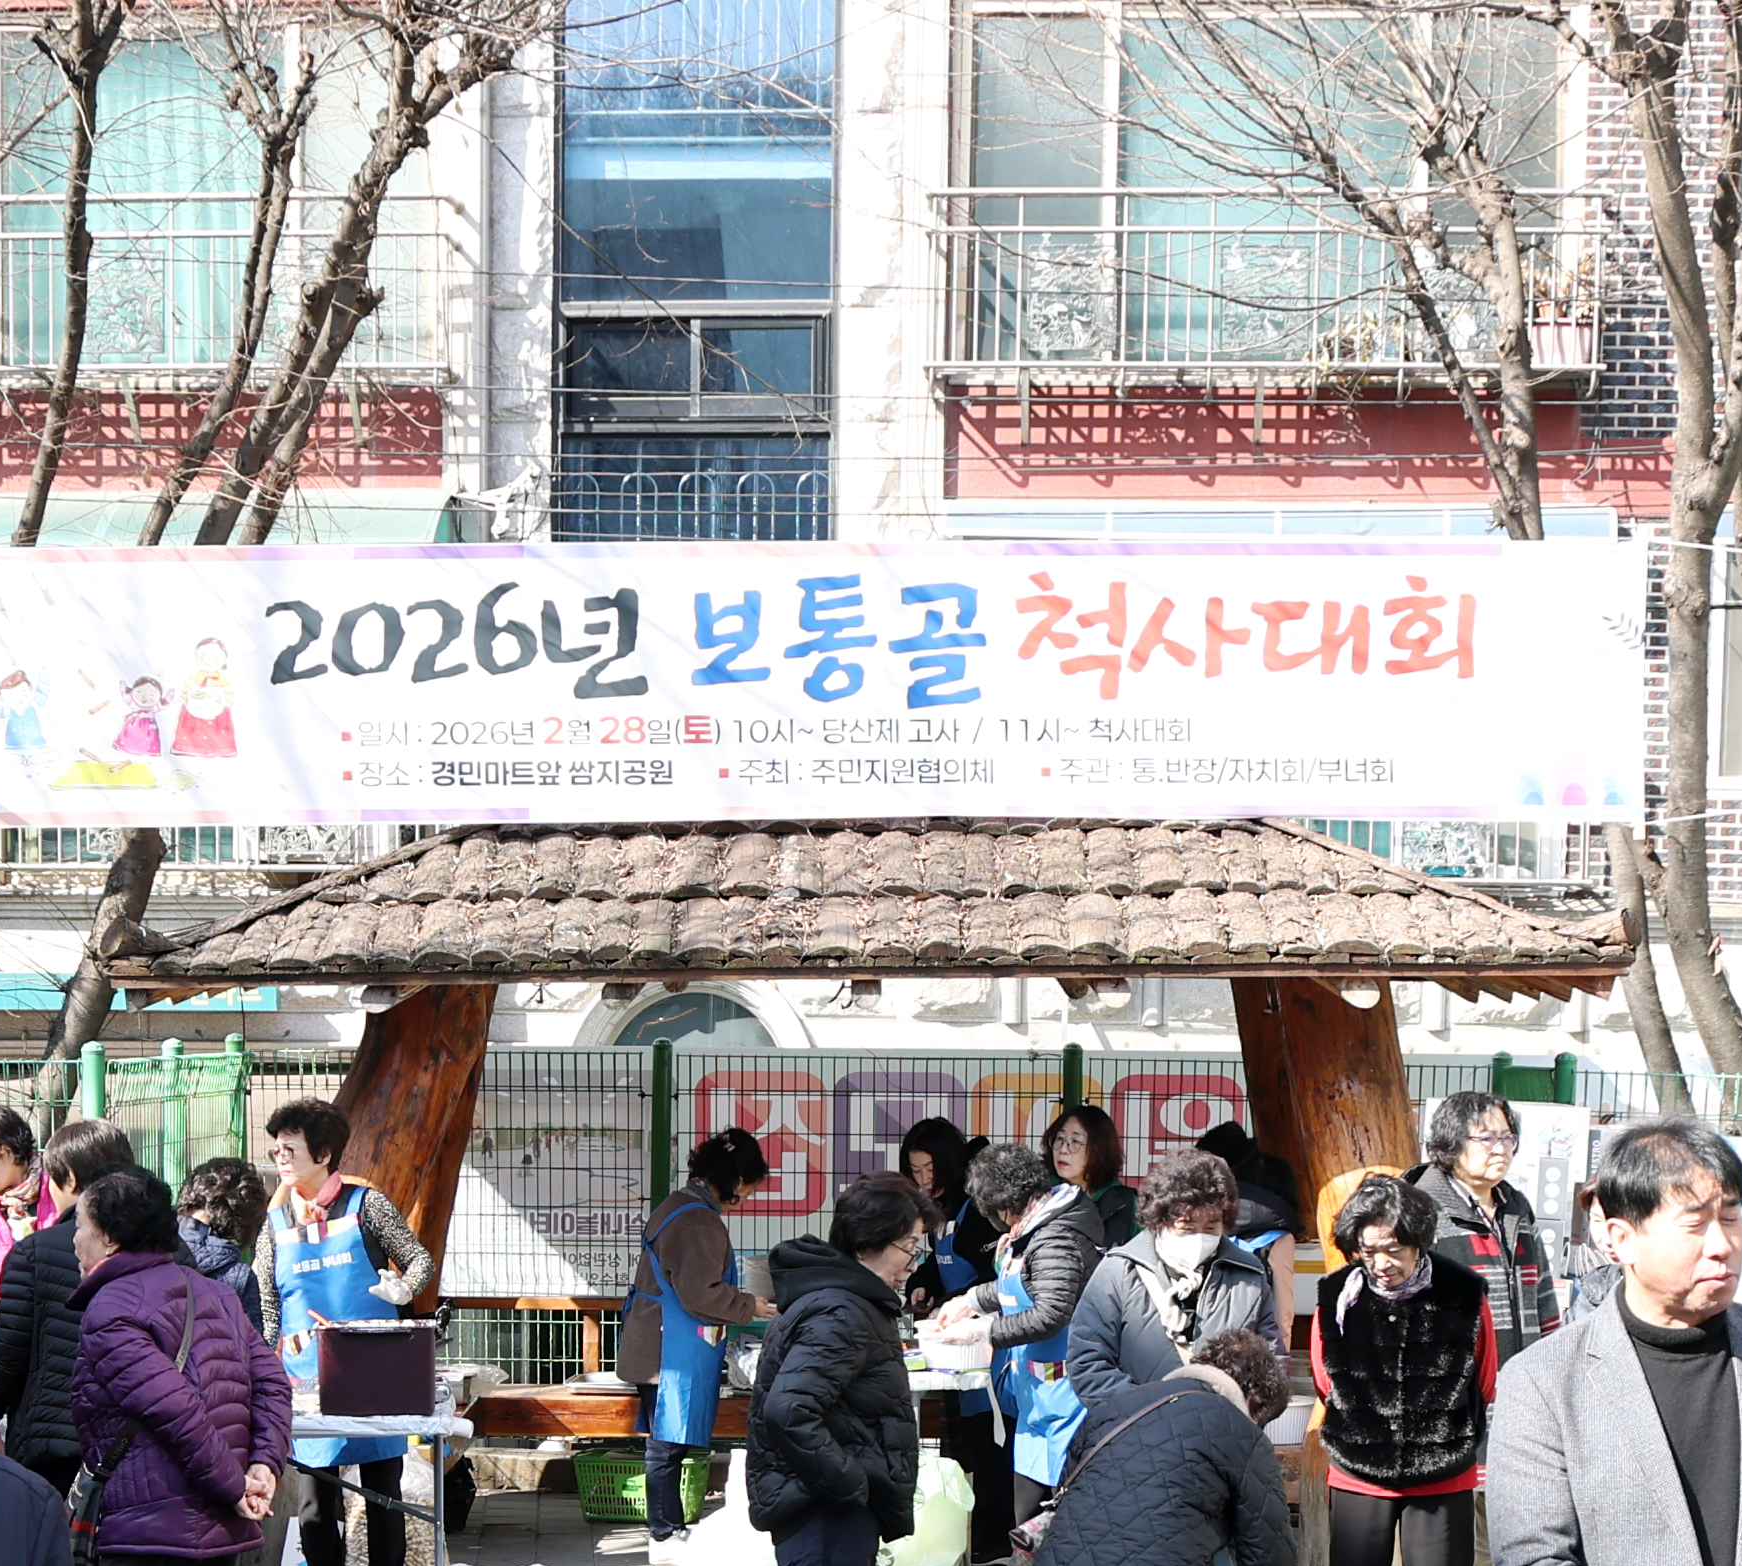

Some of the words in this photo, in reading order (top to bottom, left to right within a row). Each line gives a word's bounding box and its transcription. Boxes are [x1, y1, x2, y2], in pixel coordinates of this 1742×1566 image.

[264, 580, 649, 700] 2026년
[691, 573, 988, 708] 보통골
[1015, 571, 1477, 700] 척사대회
[358, 720, 409, 746] 일시
[431, 720, 535, 746] 2026년
[542, 715, 591, 746] 2월
[599, 714, 721, 746] 28일(토)
[732, 717, 814, 745] 10시~
[822, 717, 899, 745] 당산제
[908, 717, 960, 744] 고사
[999, 717, 1079, 744] 11시~
[1088, 717, 1191, 744] 척사대회
[359, 760, 411, 787] 장소
[431, 760, 561, 787] 경민마트앞
[568, 760, 673, 787] 쌈지공원
[738, 758, 789, 785] 주최
[811, 758, 994, 785] 주민지원협의체
[1059, 757, 1111, 784] 주관
